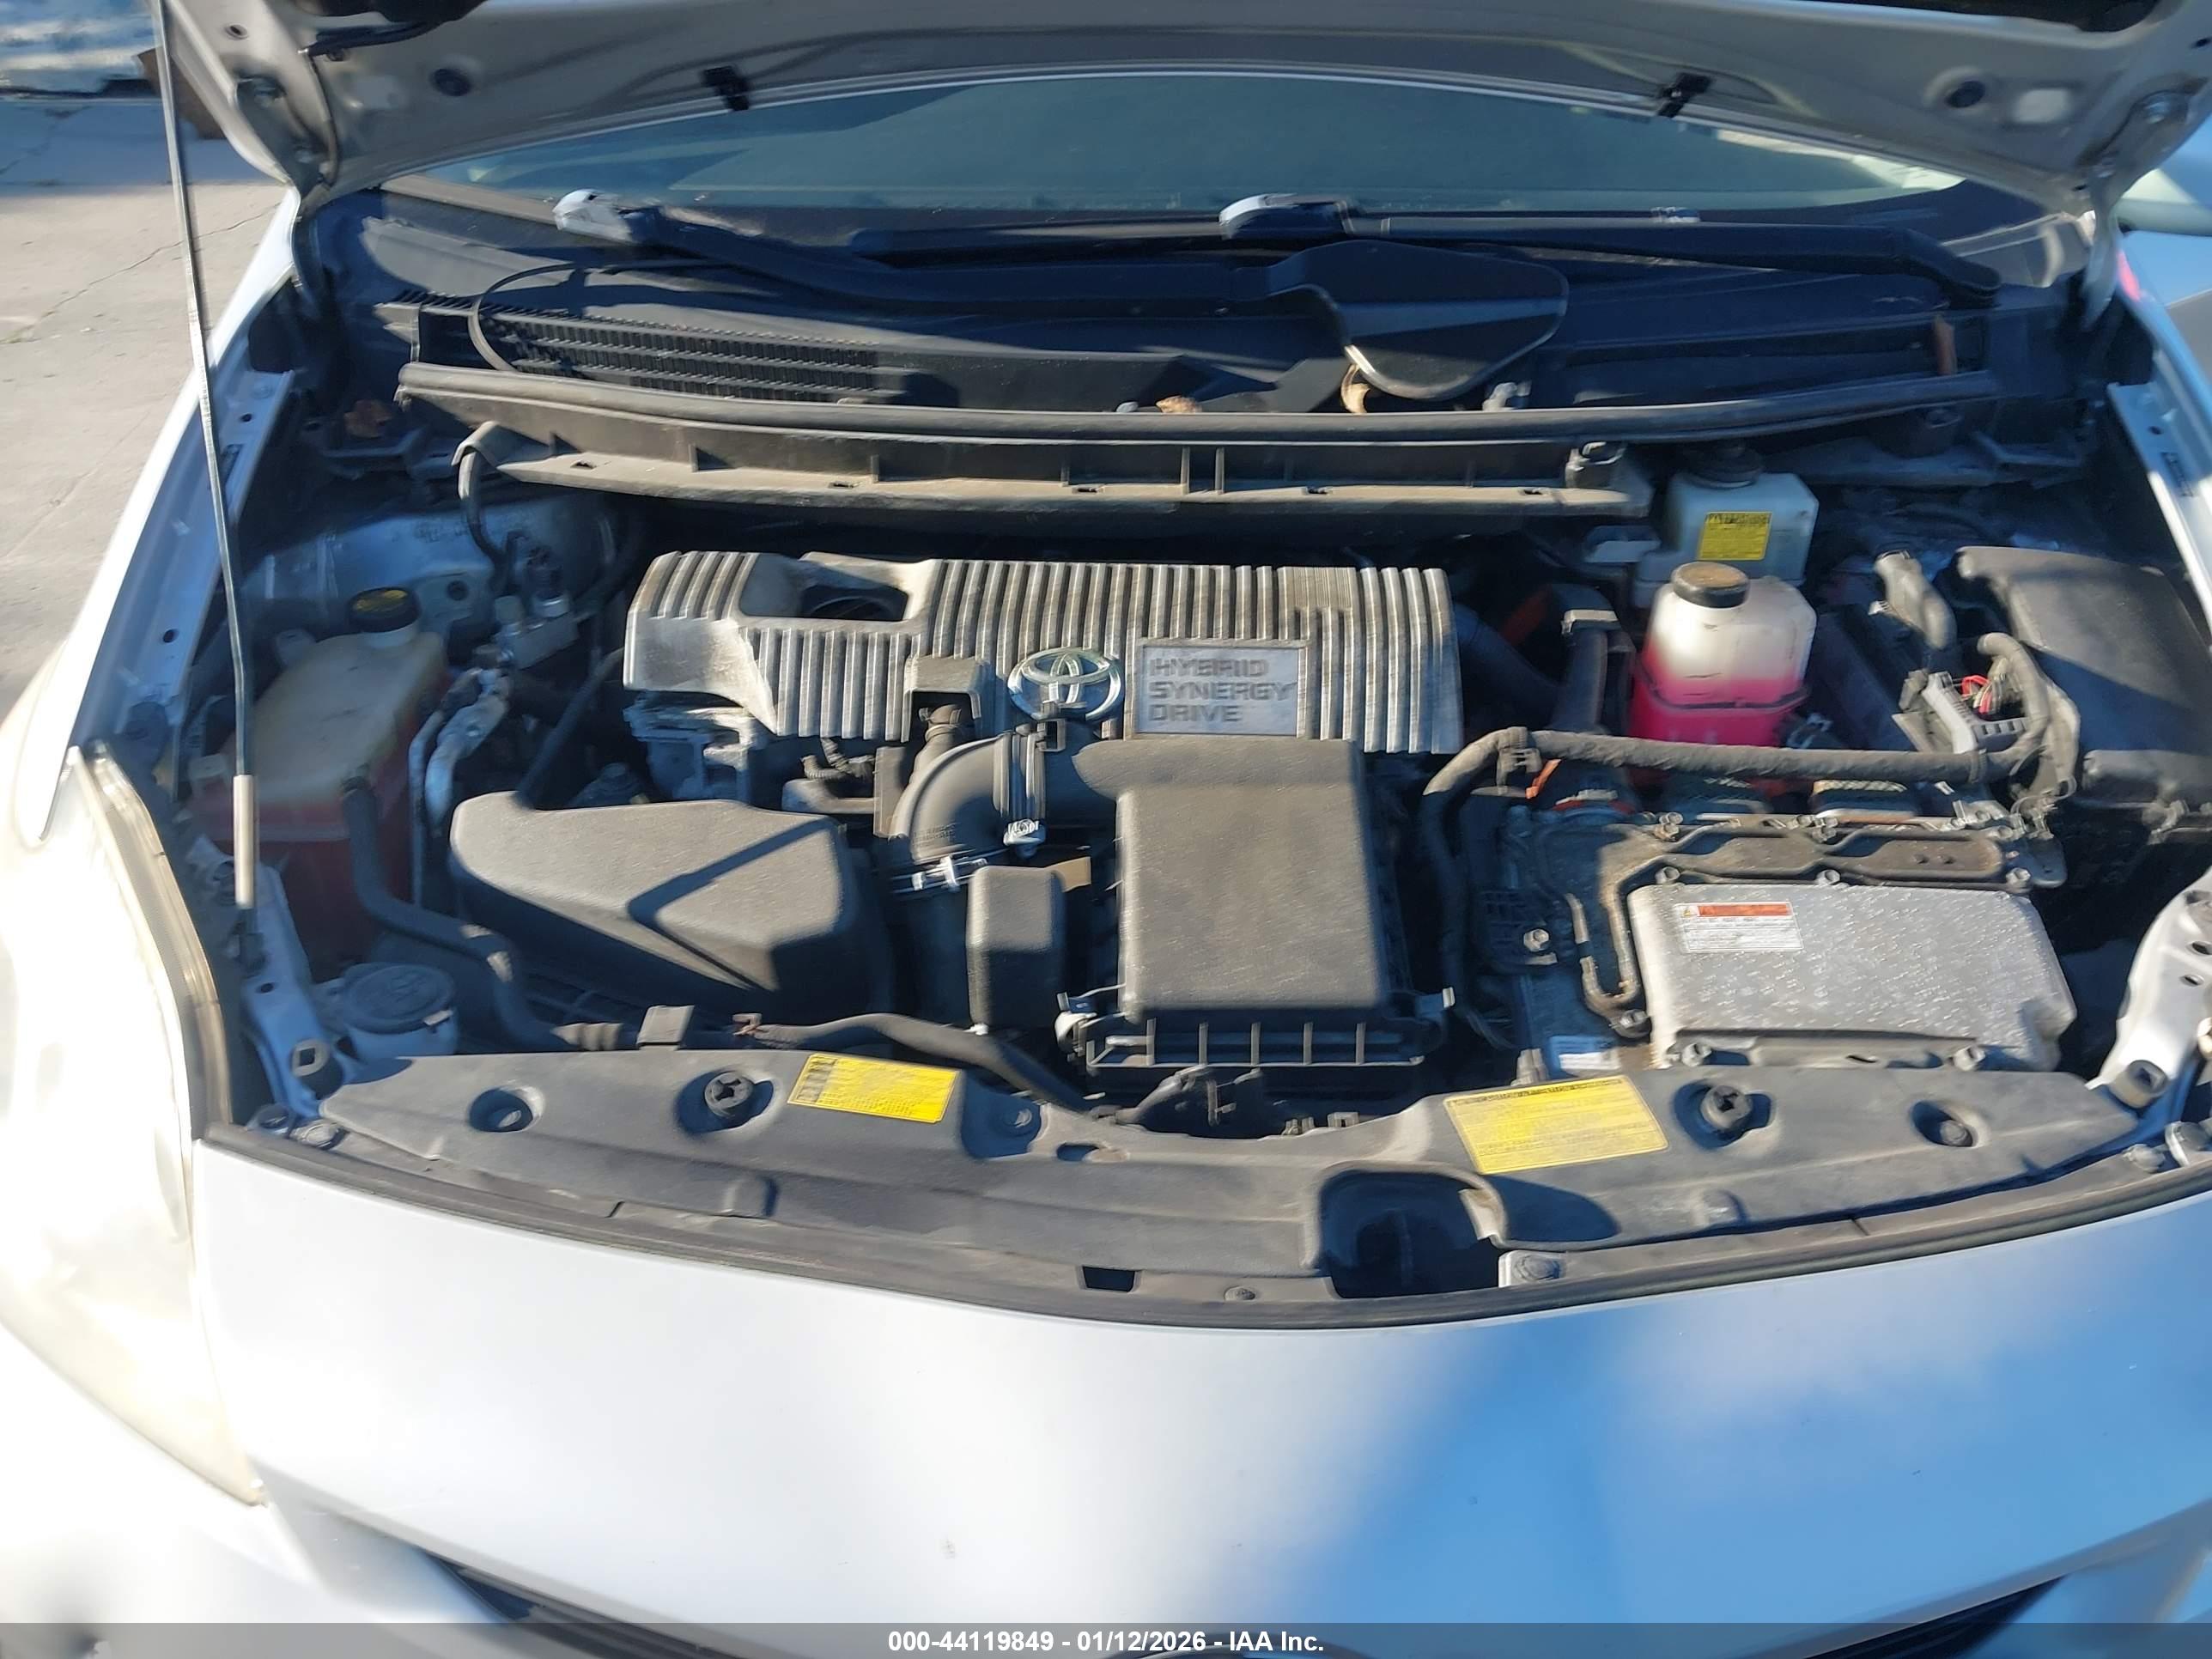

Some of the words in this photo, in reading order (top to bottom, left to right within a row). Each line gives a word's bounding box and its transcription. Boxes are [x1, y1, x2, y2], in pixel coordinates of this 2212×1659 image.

[1149, 659, 1269, 678] HYBRID
[1148, 681, 1297, 701] SYNERGY
[1148, 704, 1243, 722] DRIVE
